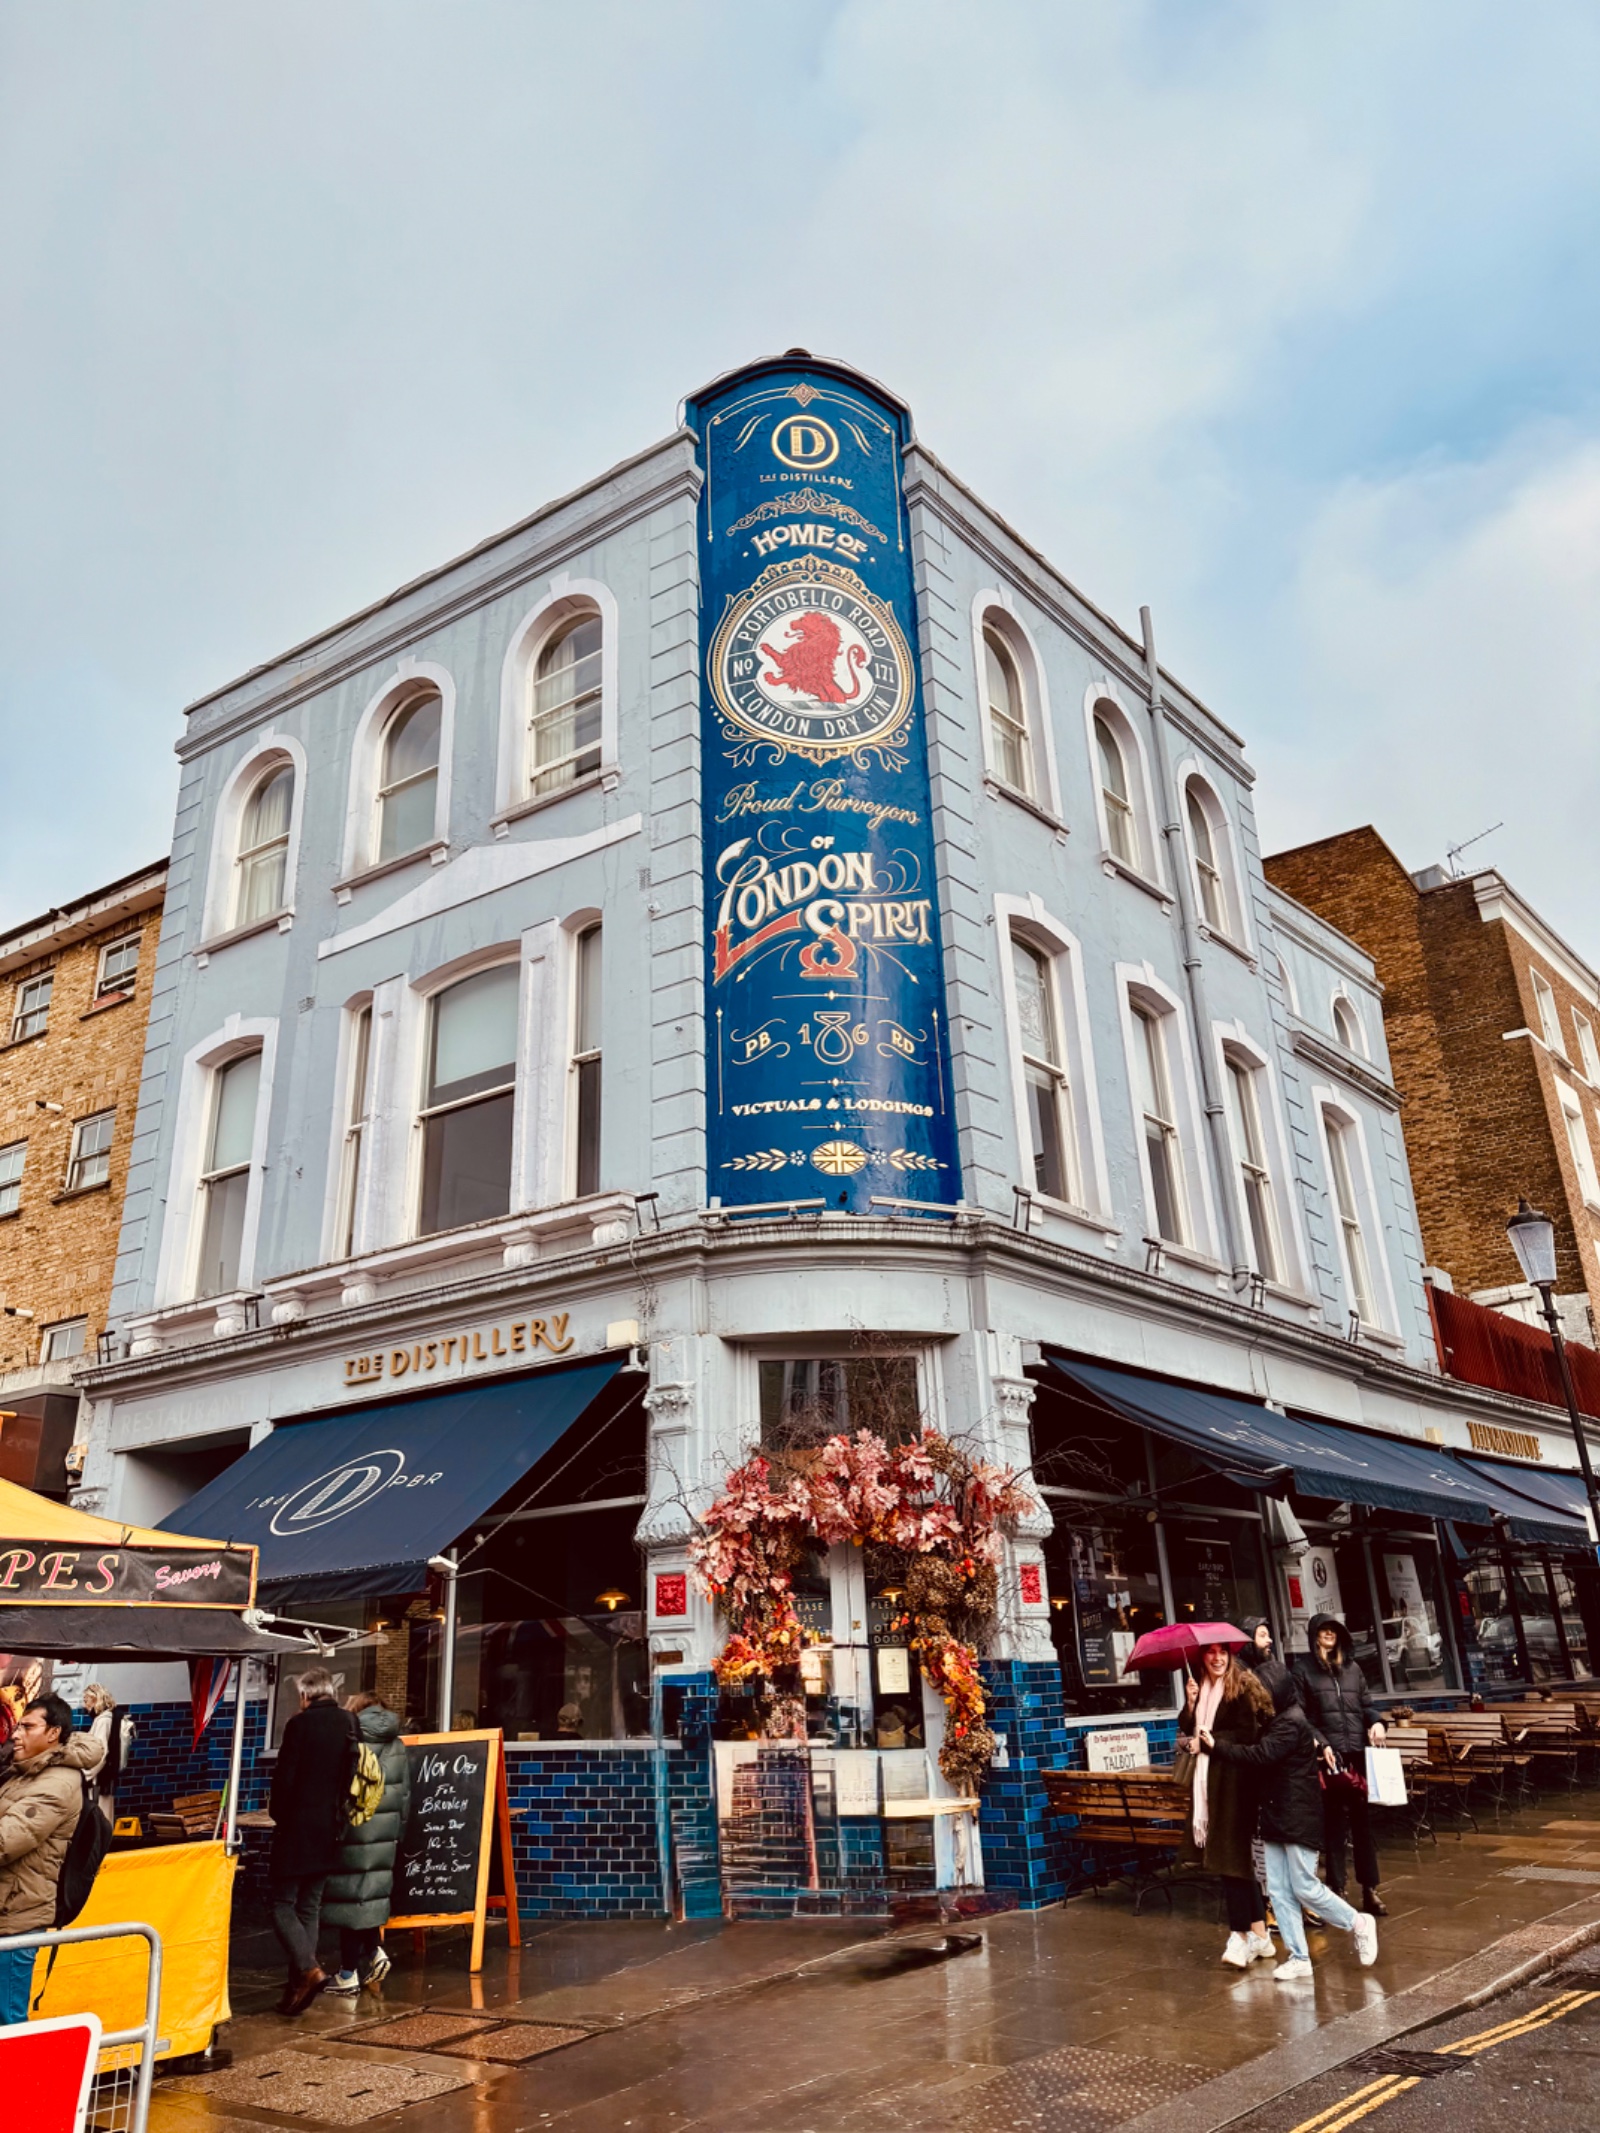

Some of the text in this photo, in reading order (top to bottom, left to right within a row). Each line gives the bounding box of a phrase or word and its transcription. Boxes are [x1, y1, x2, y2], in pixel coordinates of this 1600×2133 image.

[789, 426, 826, 457] D
[780, 473, 853, 489] DISTILLERY
[751, 523, 869, 557] HOME OF
[738, 589, 886, 649] PORTOBELLO ROAD
[874, 664, 895, 683] 171
[739, 689, 892, 738] LONDON DRY GIN
[715, 778, 921, 829] Proud Purveyors
[811, 835, 835, 850] OF
[712, 837, 879, 987] LONDON
[799, 898, 932, 979] SPIRIT
[744, 1030, 772, 1058] PB
[891, 1028, 916, 1055] RD
[731, 1098, 934, 1118] VICTUALS & LODGINGS
[343, 1312, 574, 1385] THE DISTILLERY
[120, 1389, 251, 1434] RESTAURANT
[388, 1472, 443, 1488] PBR
[155, 1560, 222, 1590] Savory
[1103, 1753, 1135, 1771] TALBOT
